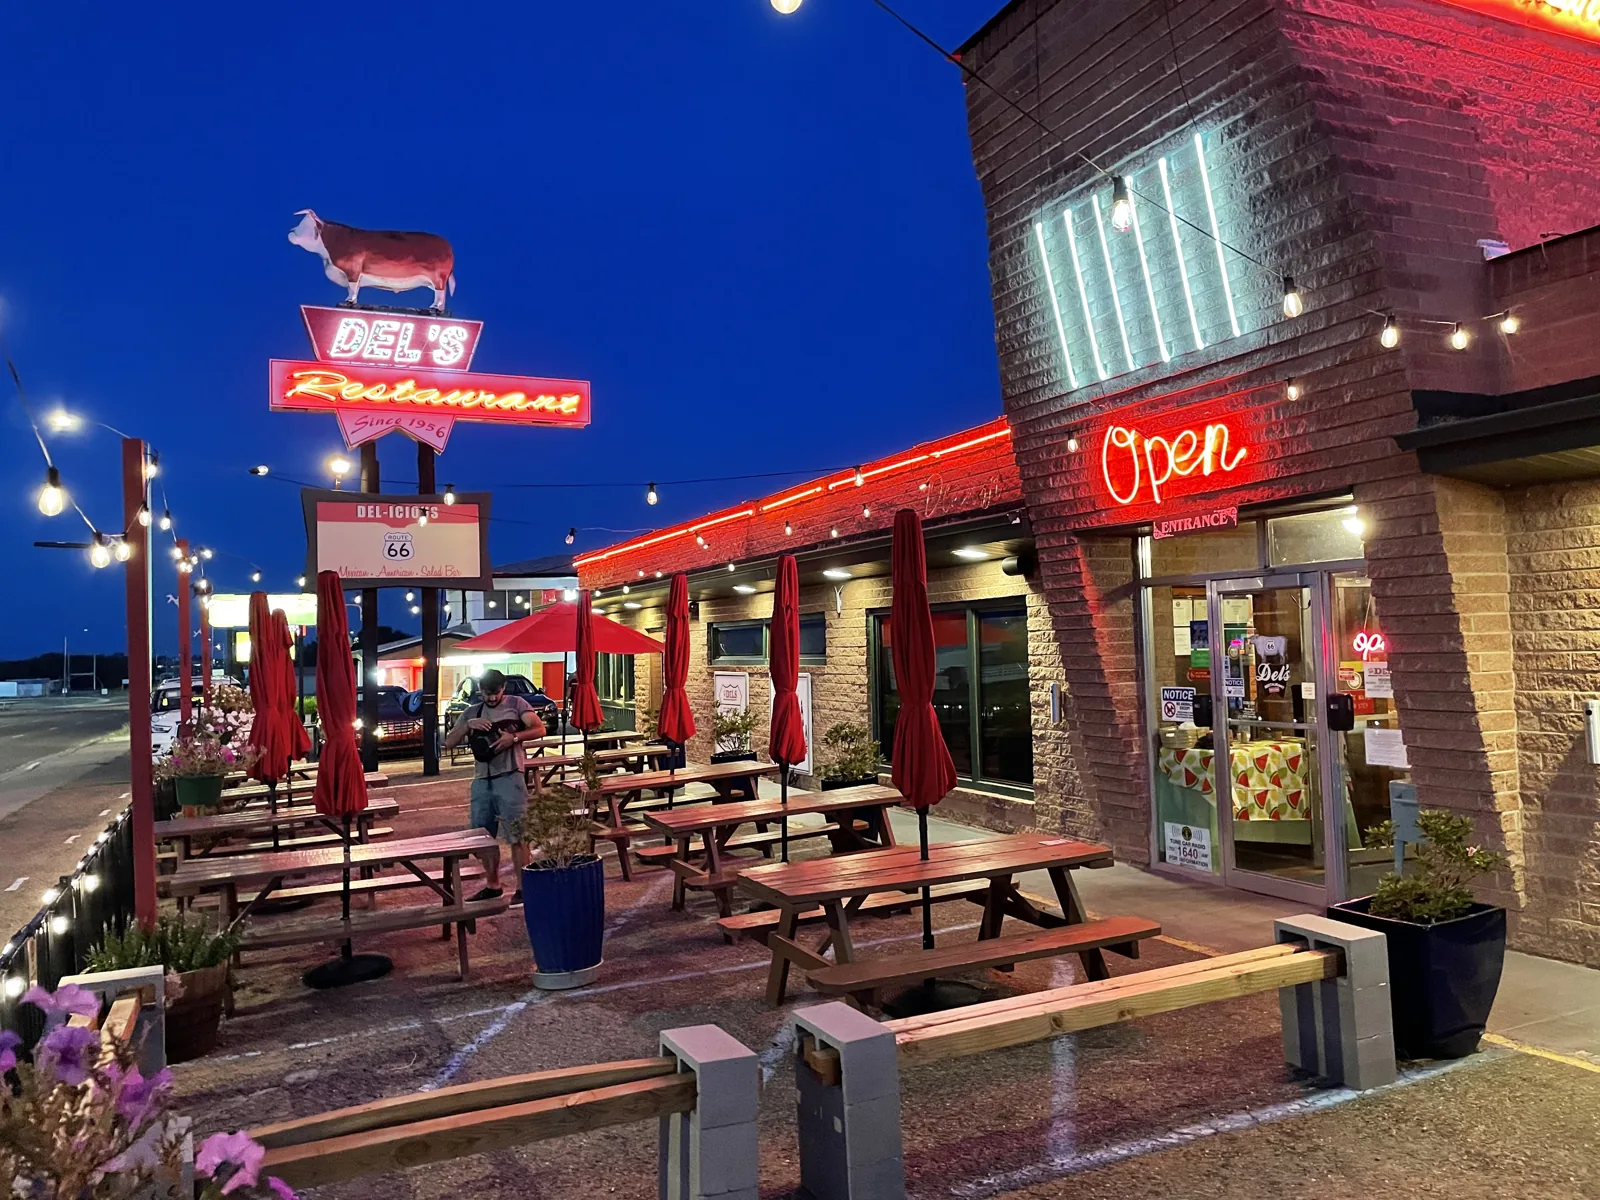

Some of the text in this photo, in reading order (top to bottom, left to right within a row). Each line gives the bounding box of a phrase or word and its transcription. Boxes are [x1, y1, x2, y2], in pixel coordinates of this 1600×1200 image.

[330, 318, 468, 365] DEL'S
[285, 371, 580, 414] Restaurant
[351, 415, 446, 438] Since 1956
[1102, 424, 1246, 505] Open
[1161, 513, 1228, 533] ENTRANCE
[387, 543, 410, 557] 66
[339, 564, 462, 577] Mexican American Salad Bar
[1255, 663, 1291, 682] Del's
[1163, 689, 1194, 701] NOTICE
[1178, 846, 1198, 859] 1640
[1180, 858, 1209, 867] INFORMATION
